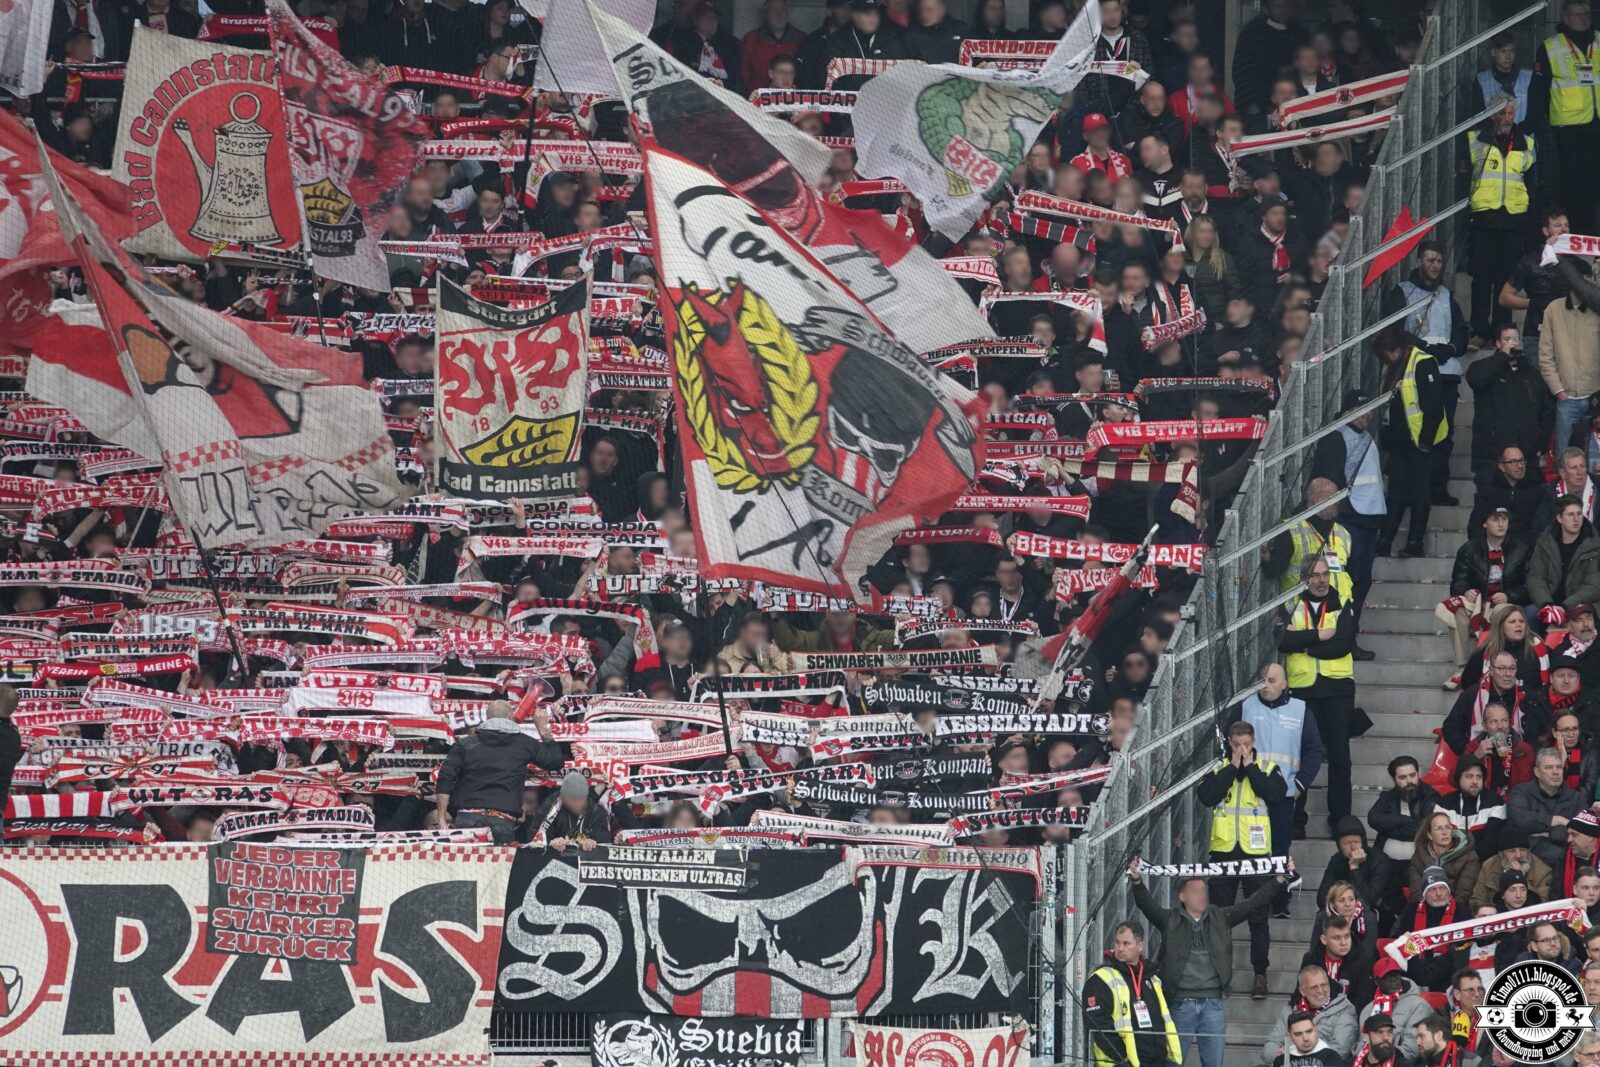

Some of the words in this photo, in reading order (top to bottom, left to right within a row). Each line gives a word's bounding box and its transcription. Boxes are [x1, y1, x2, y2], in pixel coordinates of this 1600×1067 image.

[406, 66, 437, 78] VfB
[442, 73, 523, 93] Stuttgart
[760, 90, 858, 107] STUTTGAR
[422, 144, 499, 159] uttgart
[559, 154, 582, 165] VfB
[466, 301, 559, 326] Stuttgart
[471, 416, 490, 433] 18
[539, 396, 560, 414] 93
[1112, 425, 1142, 437] VfB
[1146, 421, 1248, 436] STUTTGART
[1014, 443, 1085, 456] STUTTGA
[479, 473, 578, 493] Cannstatt
[530, 521, 658, 533] CONCORDIA
[482, 539, 511, 549] VfB
[517, 538, 589, 550] Stuttgart
[293, 611, 367, 623] EINZELNE
[139, 614, 218, 643] 1893
[69, 646, 89, 657] IST
[95, 644, 120, 654] DER
[128, 643, 145, 653] 12.
[806, 654, 885, 670] SCHWABEN
[909, 649, 982, 667] KOMPANIE
[47, 666, 88, 676] VEREIN
[143, 660, 182, 672] MEINE
[864, 683, 942, 706] Schwaben
[934, 713, 1092, 737] KESSELSTADT
[150, 763, 179, 775] 97
[793, 779, 877, 805] Schwaben
[11, 820, 48, 833] Sick
[51, 821, 88, 834] City
[306, 809, 373, 825] STADION
[967, 806, 1090, 832] STUTTGAR
[230, 843, 341, 869] JEDER
[608, 847, 657, 863] EHRE
[658, 848, 717, 865] ALLEN
[1140, 855, 1288, 876] ESSELSTADT
[214, 857, 357, 895] VERBANNTE
[580, 865, 688, 883] VERSTORBENEN
[689, 869, 744, 887] ULTRAS
[227, 886, 345, 915] KEHRT
[1430, 930, 1465, 944] VfB
[1472, 910, 1566, 936] Stuttgart
[214, 929, 352, 961] ZURÜCK
[678, 1017, 802, 1055] Suebia
